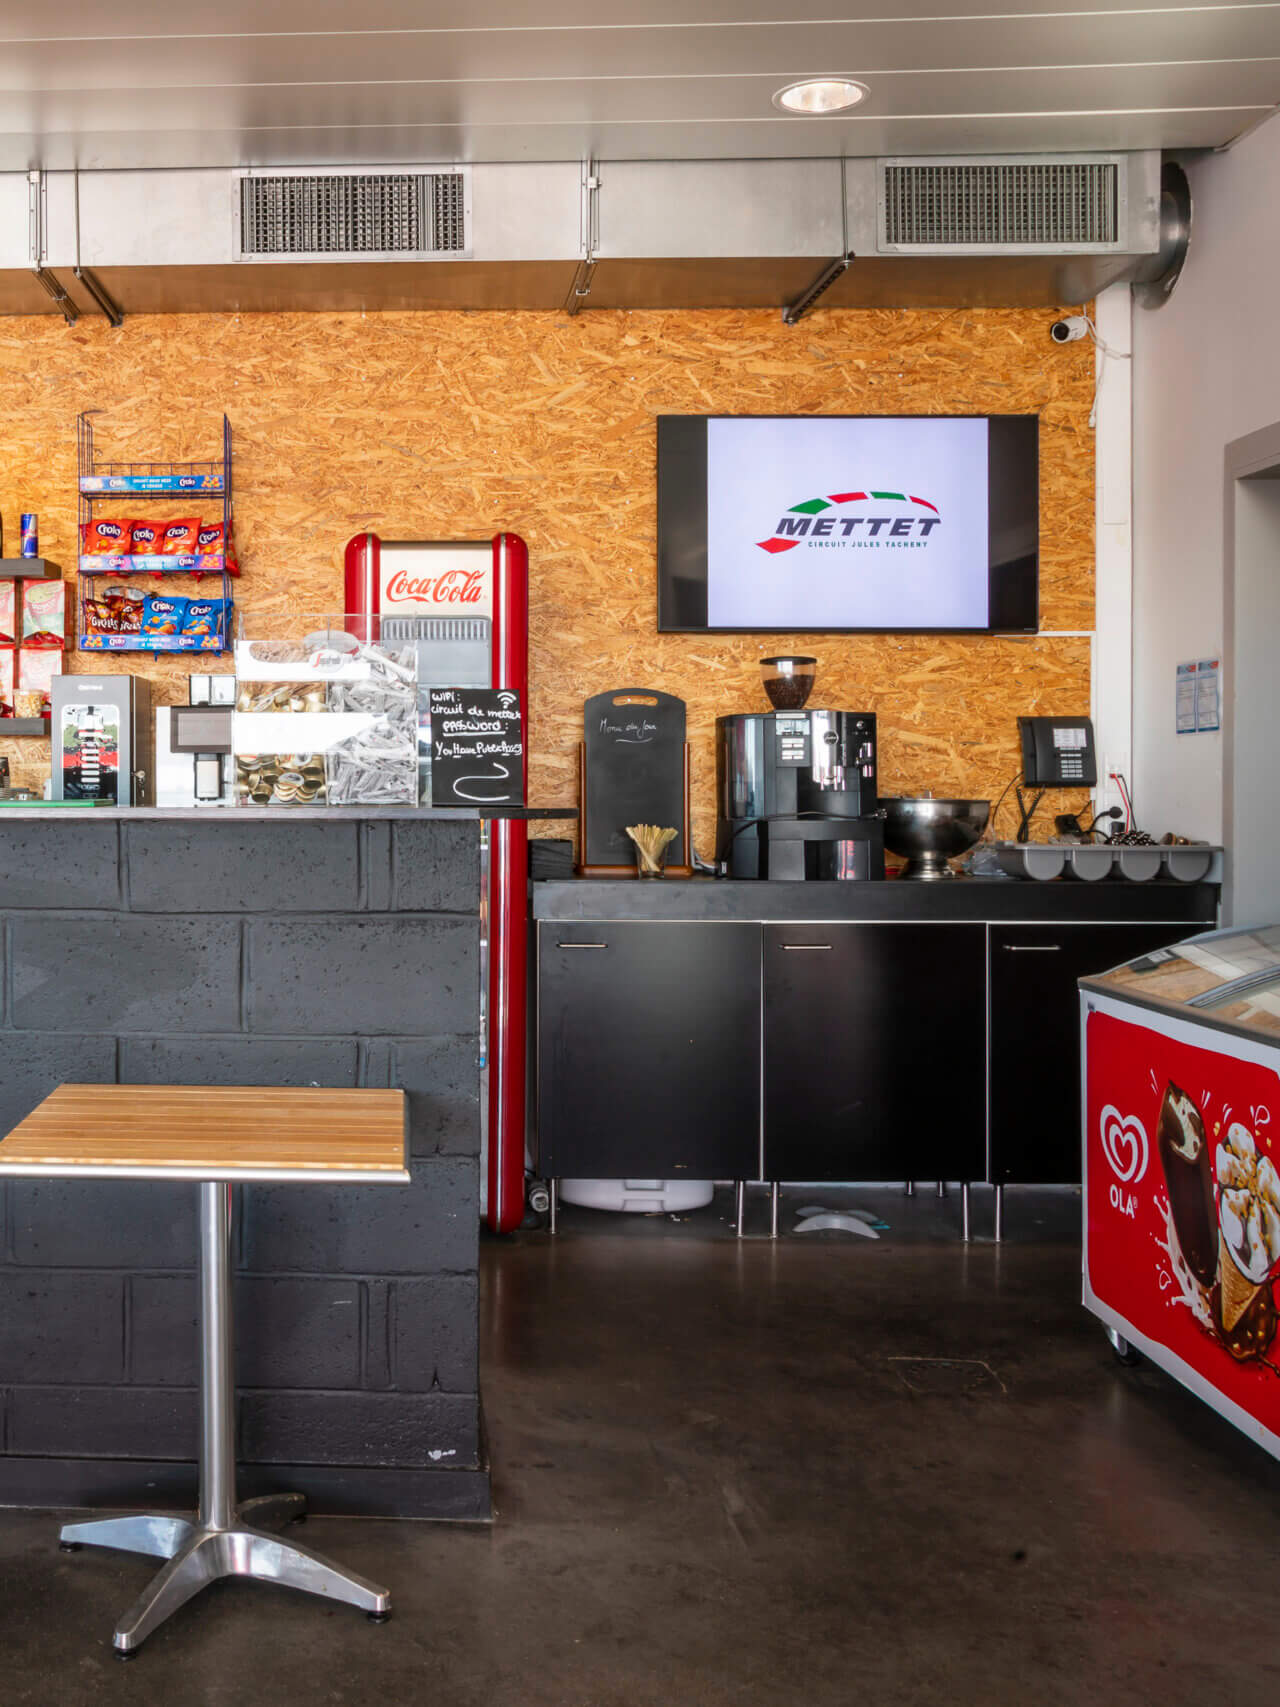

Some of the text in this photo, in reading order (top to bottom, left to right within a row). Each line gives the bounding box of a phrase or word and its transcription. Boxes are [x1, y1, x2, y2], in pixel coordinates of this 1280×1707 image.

[775, 518, 942, 535] METTET
[386, 570, 488, 603] Coca-Cola
[467, 706, 485, 717] de
[1110, 1184, 1135, 1219] OLA
